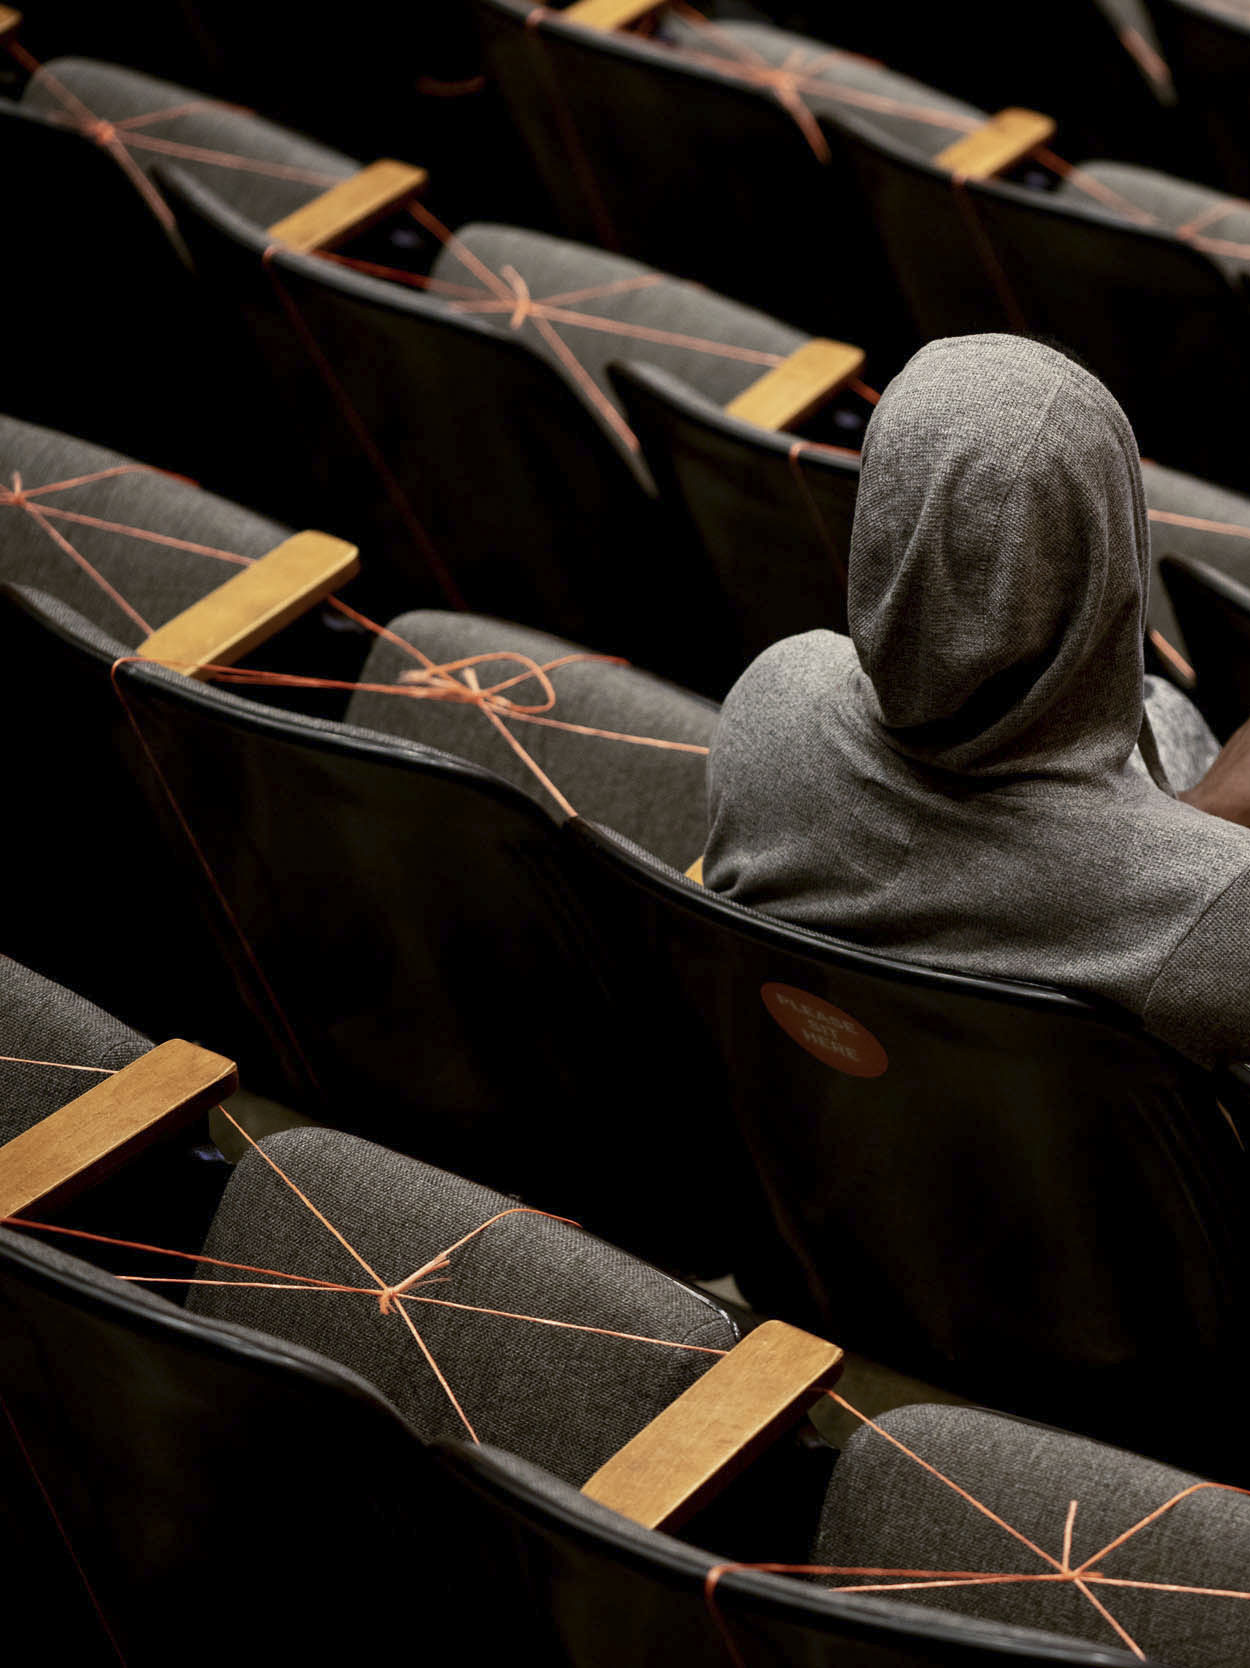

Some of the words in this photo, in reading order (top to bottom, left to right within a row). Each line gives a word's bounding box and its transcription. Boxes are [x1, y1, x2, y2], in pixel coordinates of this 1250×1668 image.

[775, 992, 860, 1035] PLEASE
[807, 1019, 839, 1040] SIT
[801, 1028, 861, 1062] HERE
